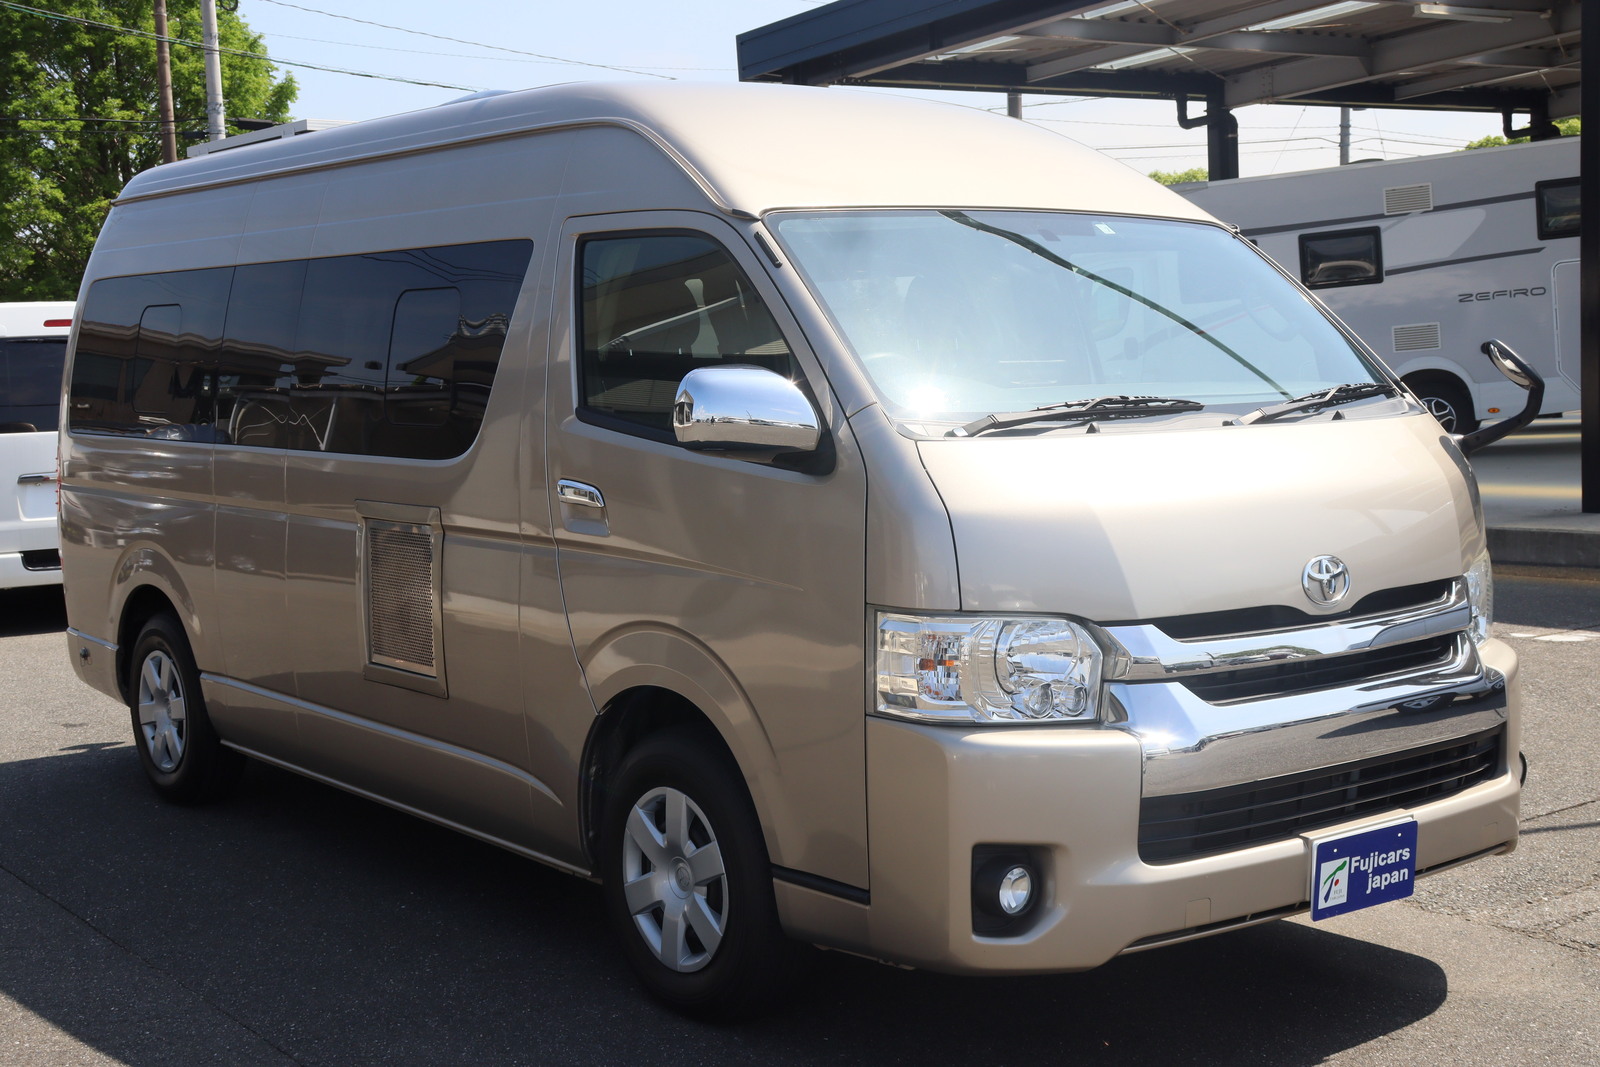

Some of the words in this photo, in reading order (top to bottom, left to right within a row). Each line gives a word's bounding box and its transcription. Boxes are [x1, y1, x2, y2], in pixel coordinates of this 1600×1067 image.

[1458, 286, 1547, 303] ZEFIRO
[1350, 848, 1411, 874] Fujicars
[1366, 868, 1409, 894] japan
